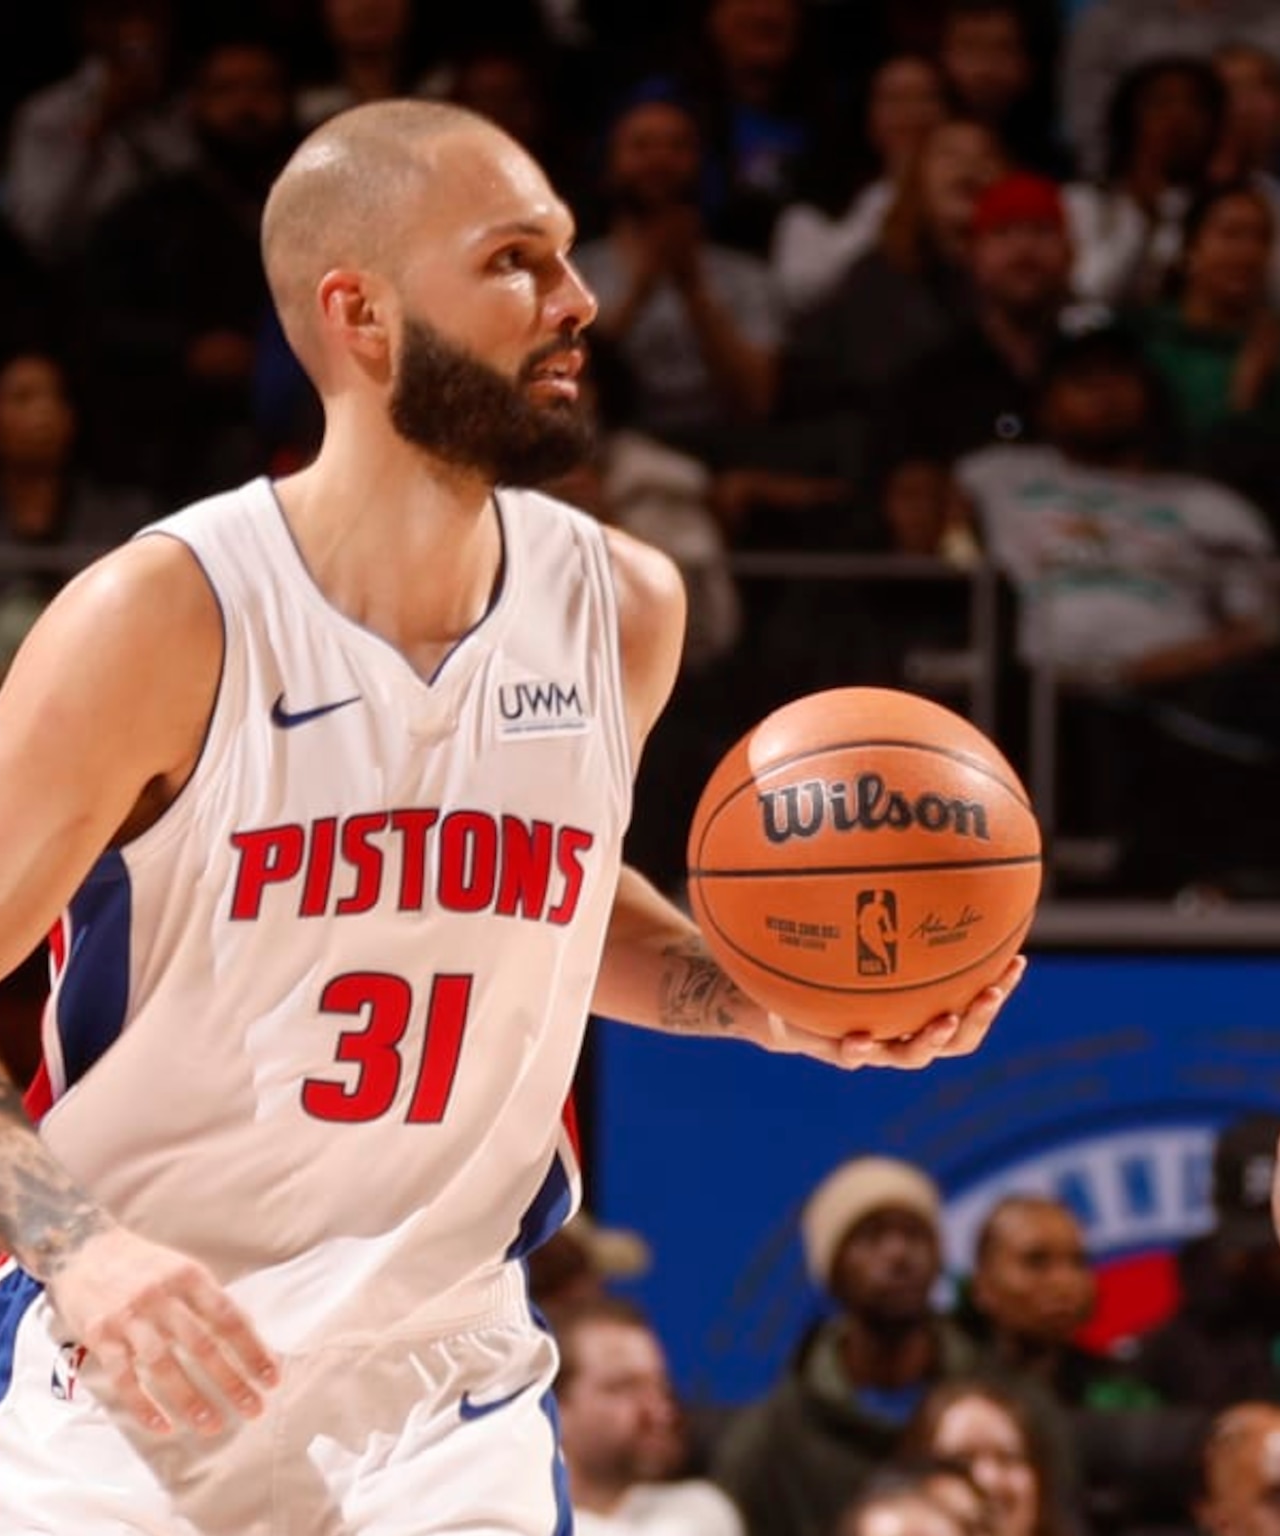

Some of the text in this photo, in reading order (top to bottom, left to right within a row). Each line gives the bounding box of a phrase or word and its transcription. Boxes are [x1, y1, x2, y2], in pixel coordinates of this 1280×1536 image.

[498, 682, 584, 720] UWM
[756, 771, 991, 845] Wilson
[229, 808, 594, 926] PISTONS
[301, 970, 475, 1125] 31
